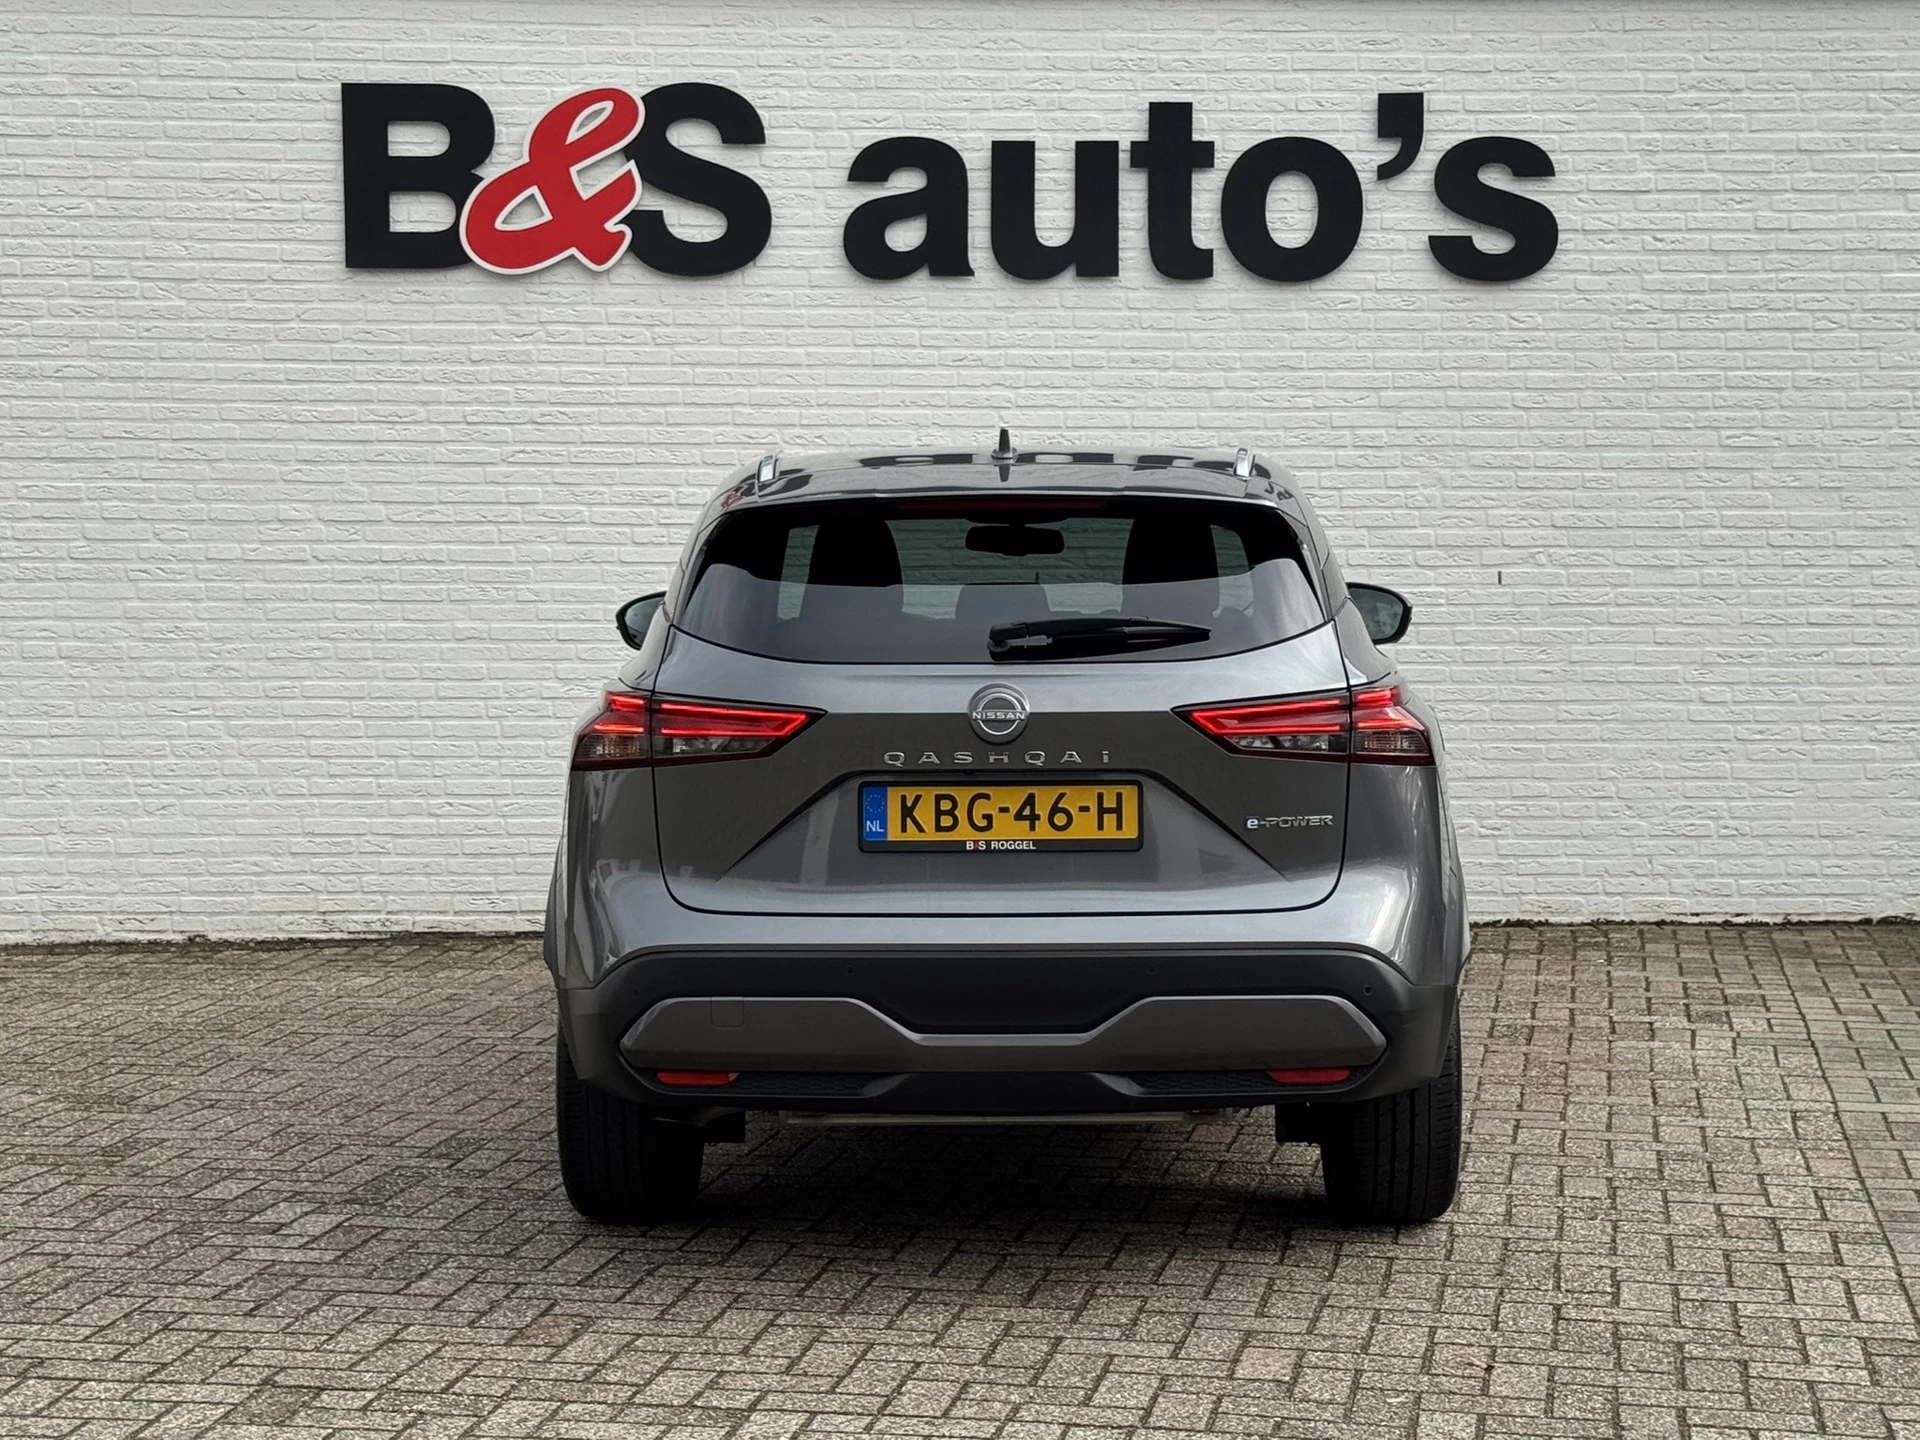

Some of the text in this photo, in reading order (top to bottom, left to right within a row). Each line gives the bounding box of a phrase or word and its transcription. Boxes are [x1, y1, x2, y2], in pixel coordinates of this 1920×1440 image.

[341, 82, 772, 276] B&S
[971, 710, 1026, 721] NISSAN
[899, 791, 1124, 834] KBG-46-H
[866, 819, 885, 833] NL
[1245, 814, 1334, 830] e-POWER
[965, 840, 1037, 851] BS ROGGEL
